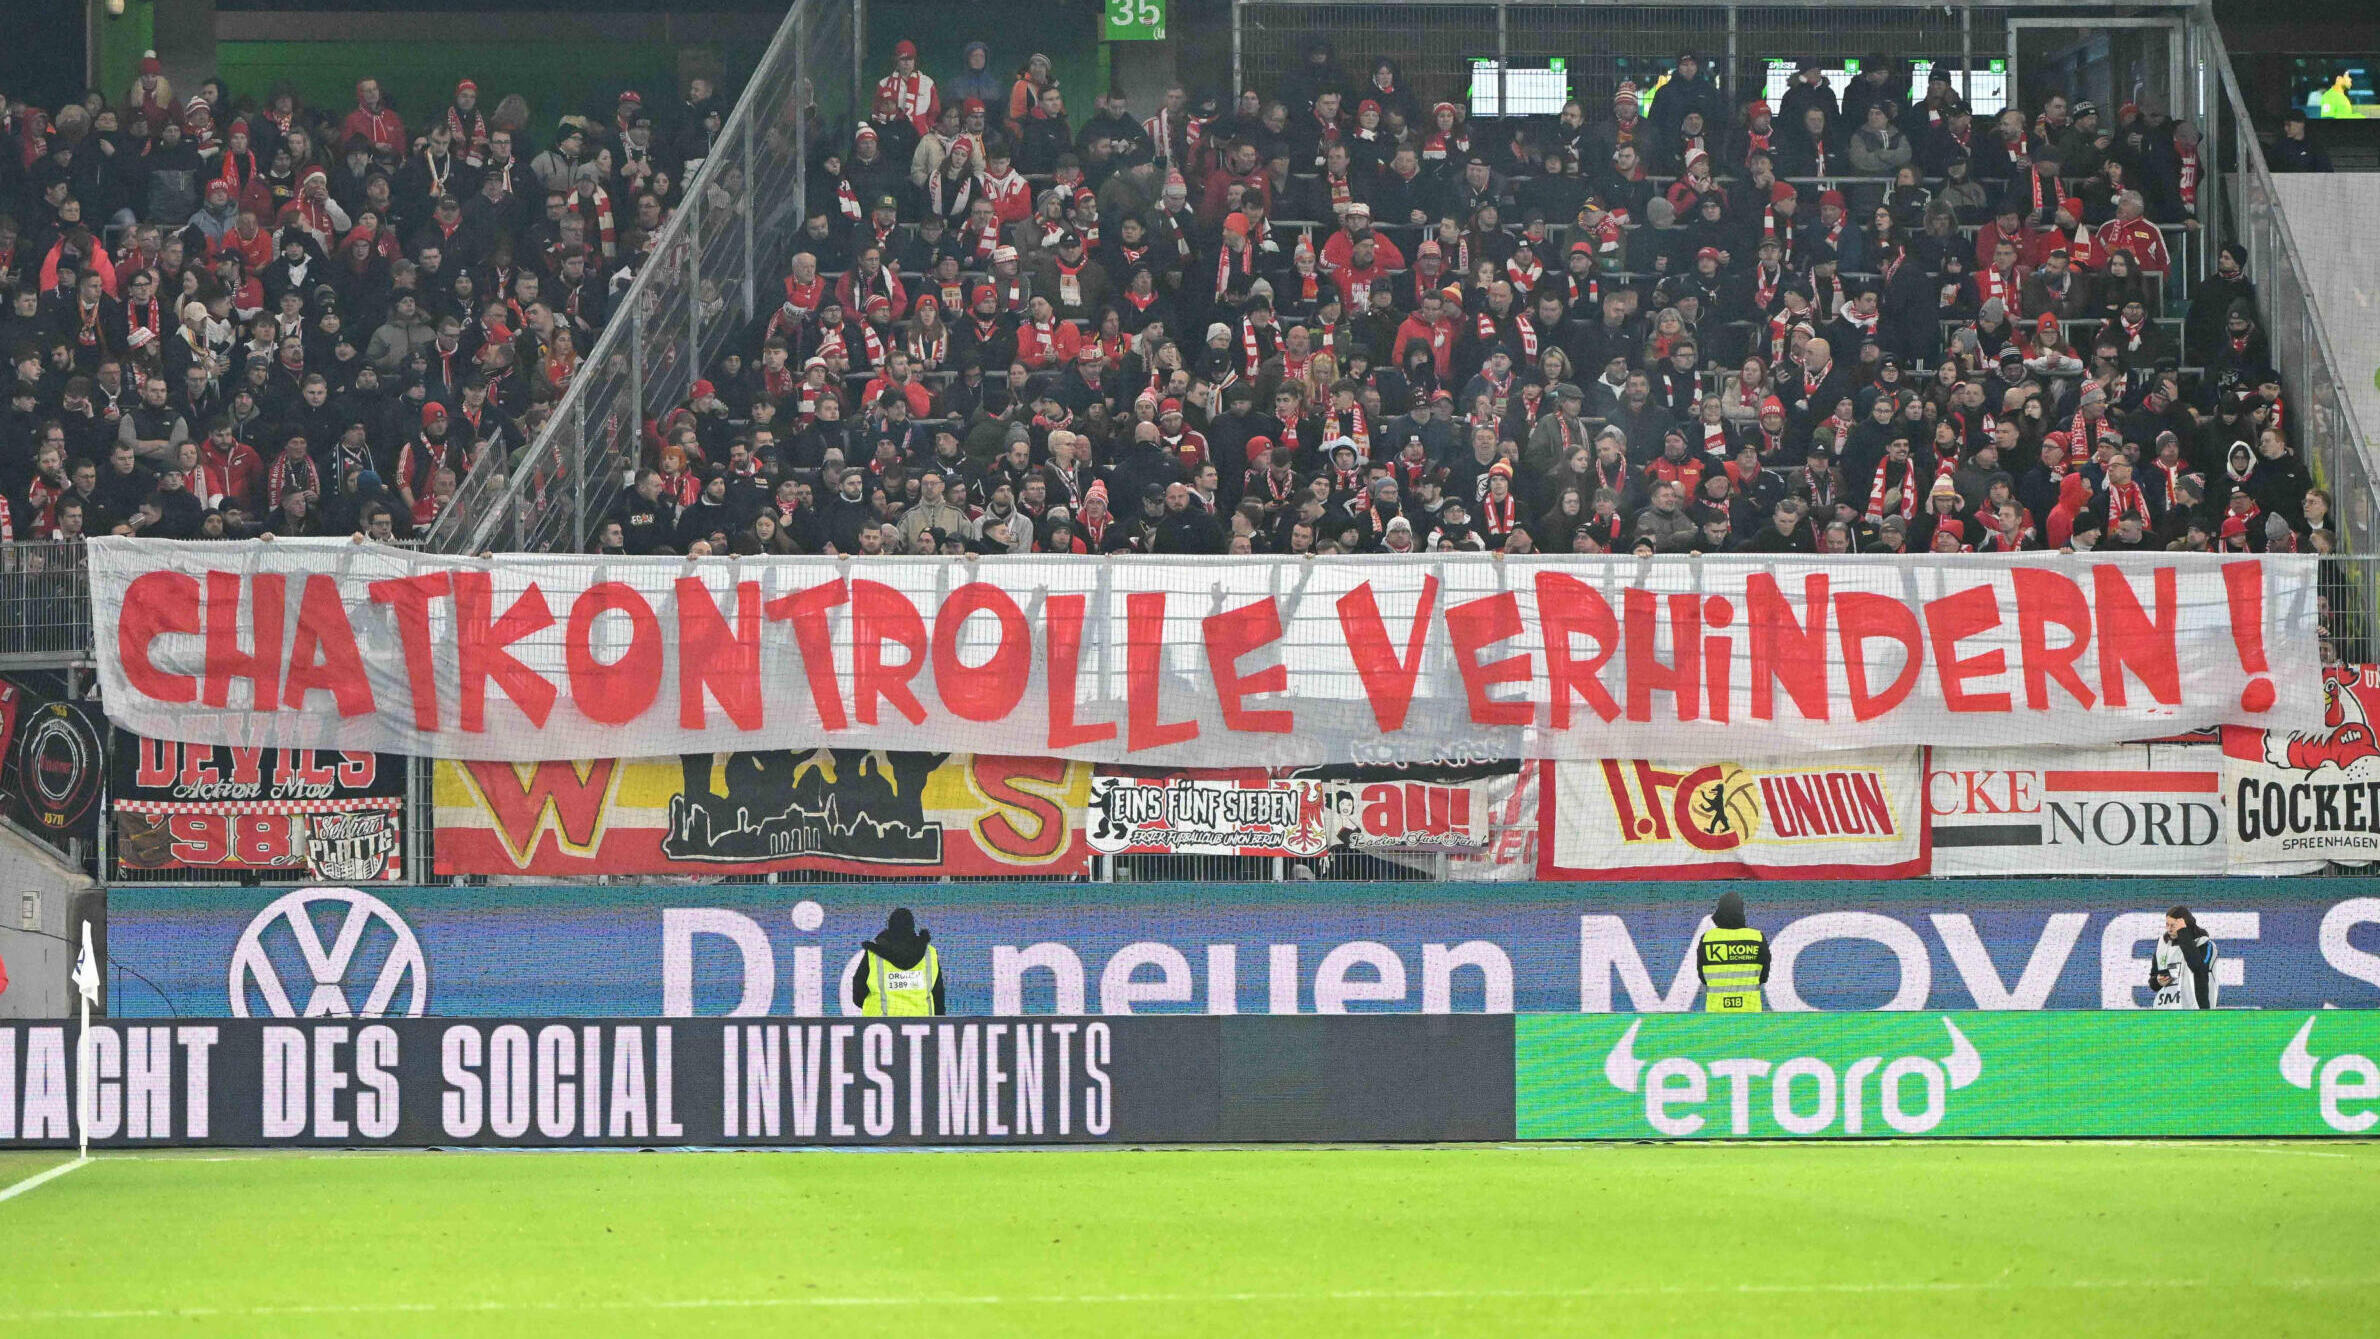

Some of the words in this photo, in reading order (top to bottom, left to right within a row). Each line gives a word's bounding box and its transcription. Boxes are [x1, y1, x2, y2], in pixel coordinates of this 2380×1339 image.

[1111, 0, 1161, 26] 35
[118, 569, 1294, 752] CHATKONTROLLE
[2220, 560, 2277, 713] !
[136, 714, 377, 789] DEVILS
[172, 775, 262, 800] Action
[270, 776, 335, 800] Mob
[1111, 787, 1164, 824] EINS
[1165, 779, 1222, 830] FÜNF
[1223, 788, 1300, 828] SIEBEN
[1361, 783, 1471, 839] au!
[1760, 772, 1894, 838] UNION
[307, 827, 394, 860] PLATTE
[2046, 801, 2220, 847] NORD
[2282, 836, 2378, 851] SPREENHAGEN
[662, 900, 866, 1017] Di
[993, 941, 1514, 1015] neuen
[1580, 910, 2259, 1012] MOVE
[888, 981, 908, 989] 1389
[1724, 998, 1741, 1007] 618
[0, 1025, 219, 1139] ACHT
[262, 1025, 400, 1139] DES
[441, 1024, 684, 1138] SOCIAL
[723, 1022, 1112, 1138] INVESTMENTS
